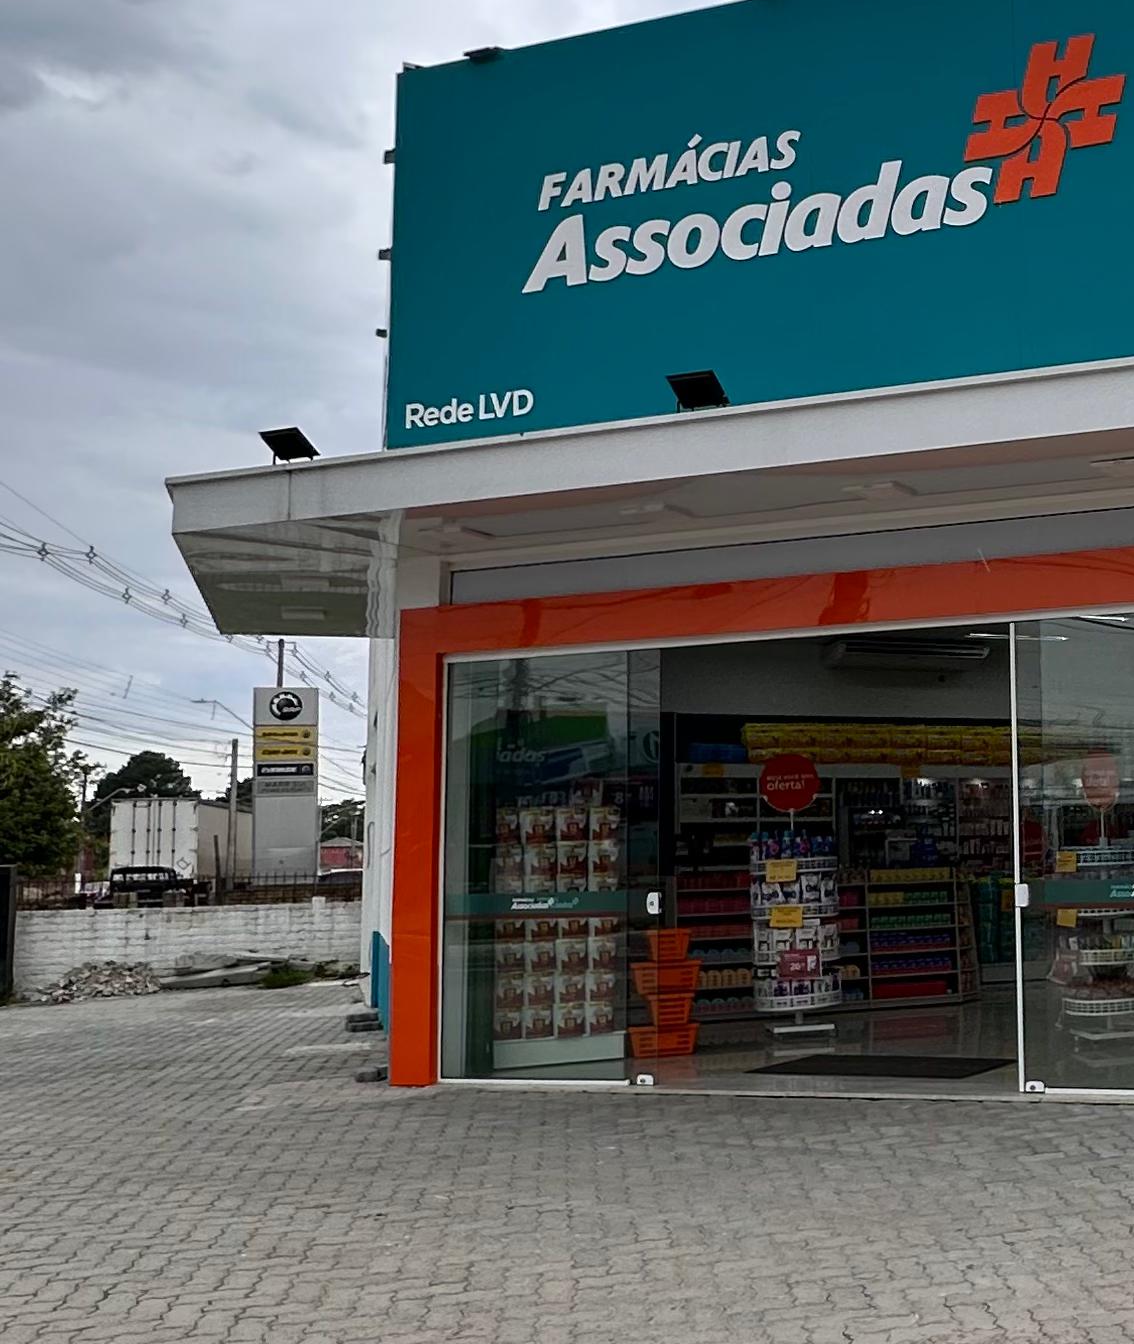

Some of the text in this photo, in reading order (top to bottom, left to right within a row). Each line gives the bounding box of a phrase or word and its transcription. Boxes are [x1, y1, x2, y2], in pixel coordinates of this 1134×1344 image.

[537, 130, 801, 211] FARMÁCIAS
[521, 159, 993, 294] Associadas
[405, 389, 534, 429] Rede LVD
